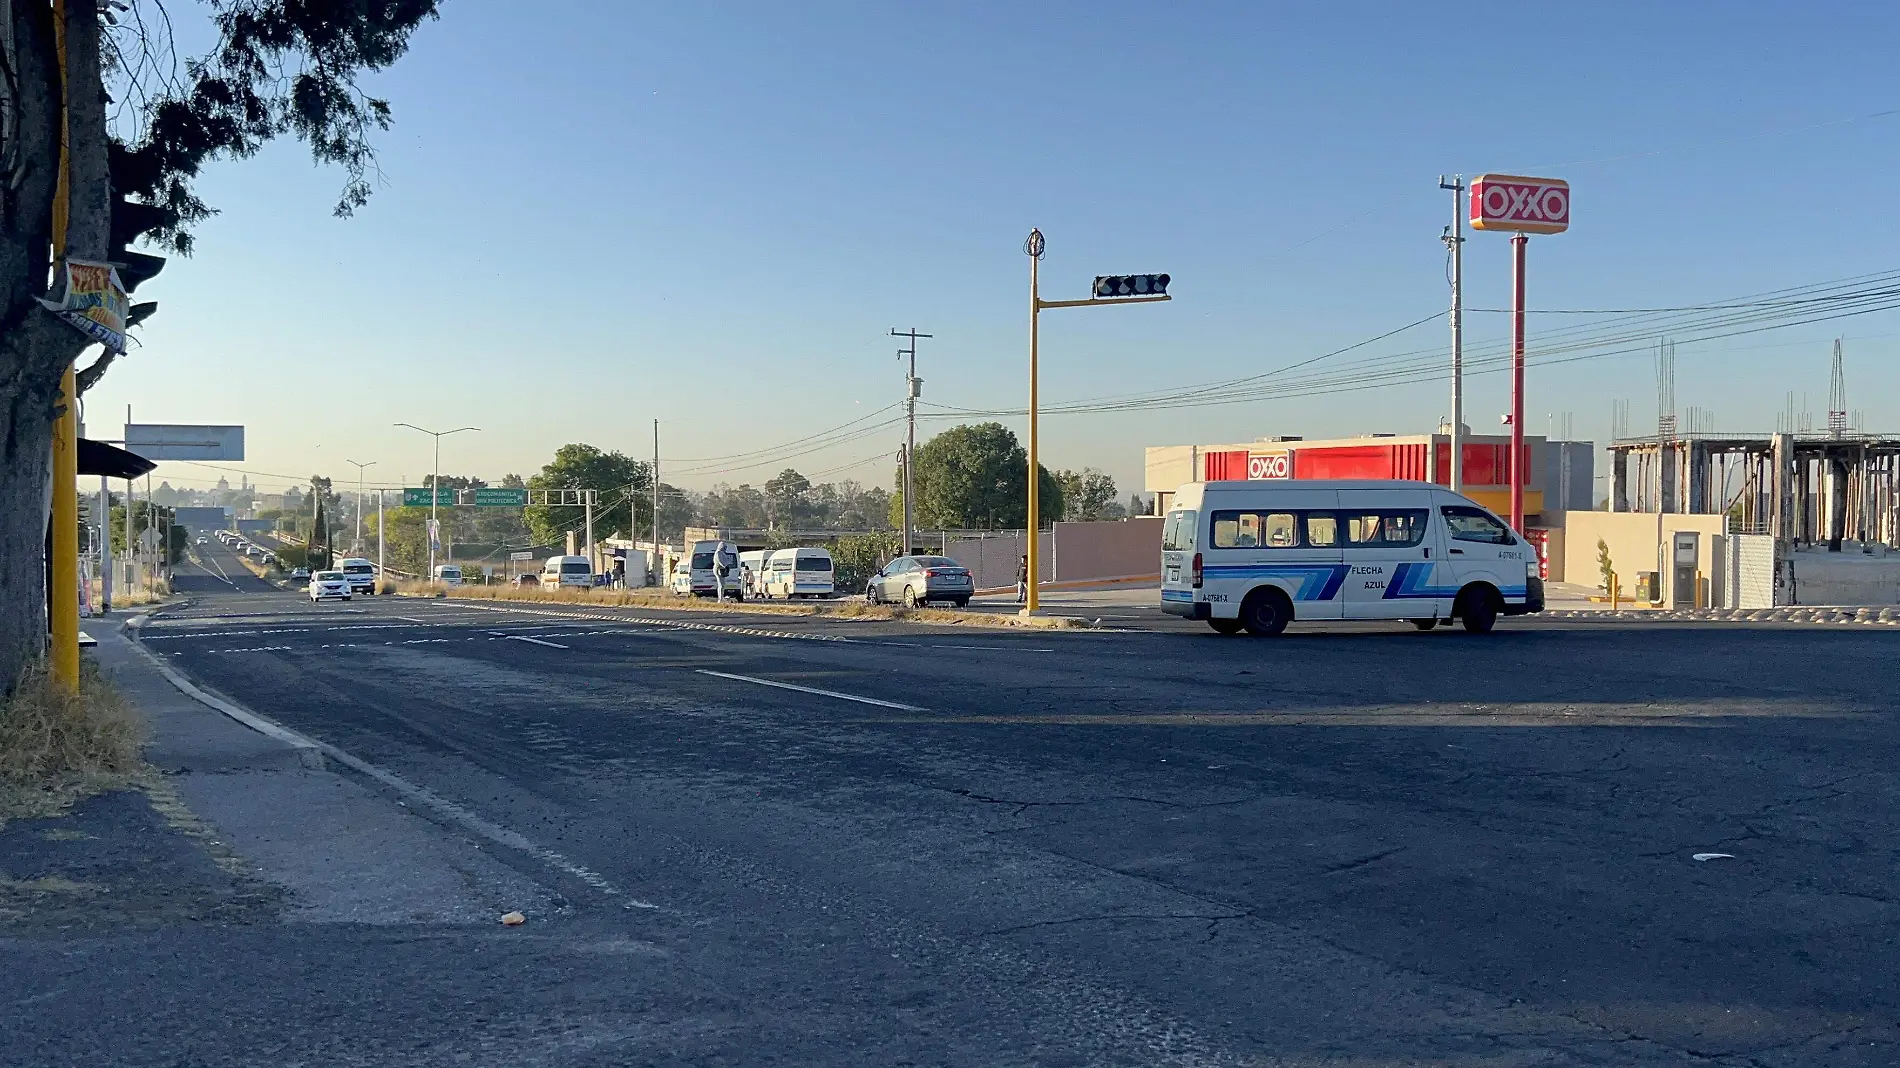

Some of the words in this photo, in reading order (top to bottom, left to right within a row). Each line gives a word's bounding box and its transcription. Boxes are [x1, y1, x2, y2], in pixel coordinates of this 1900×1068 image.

[1483, 185, 1567, 221] OXXO
[1250, 457, 1287, 478] OXXO
[1351, 566, 1383, 575] FLECHA
[1364, 580, 1386, 589] AZUL
